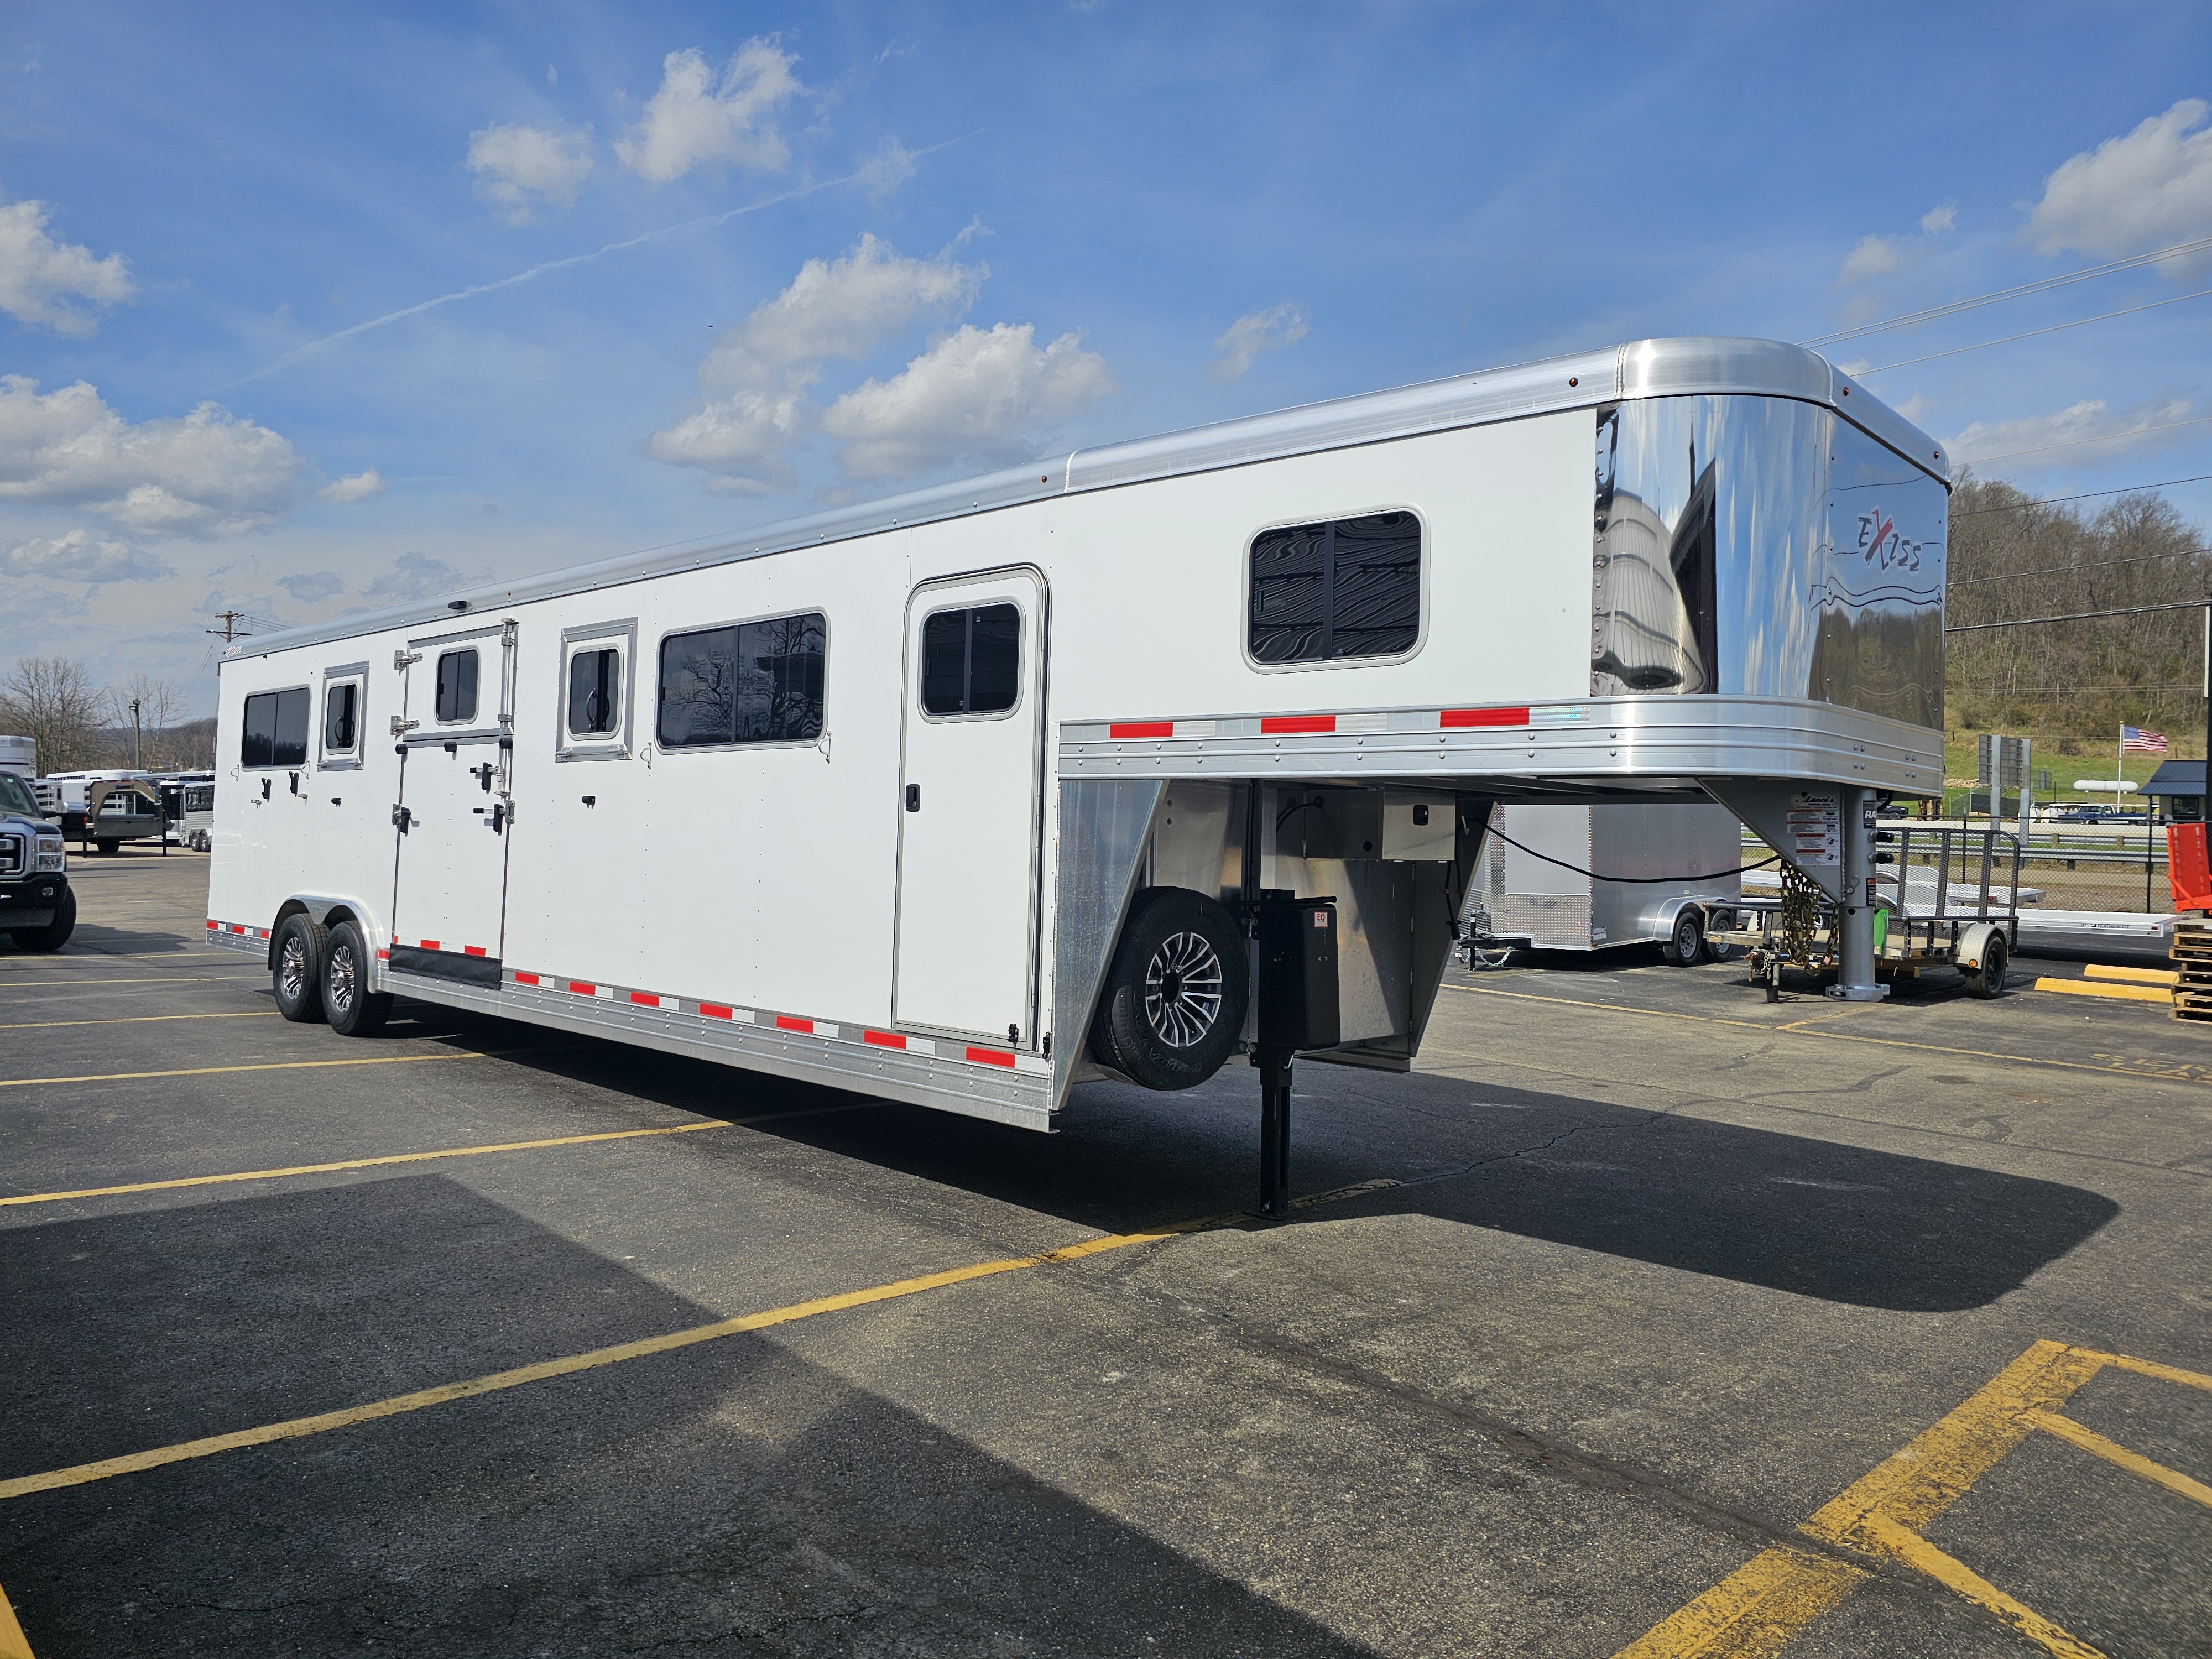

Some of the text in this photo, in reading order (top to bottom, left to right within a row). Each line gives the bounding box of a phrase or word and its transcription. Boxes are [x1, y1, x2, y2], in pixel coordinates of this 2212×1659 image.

[1858, 509, 1922, 572] EXISS
[1803, 795, 1834, 803] Lance's
[1864, 810, 1877, 818] RA
[1317, 914, 1325, 923] EQ
